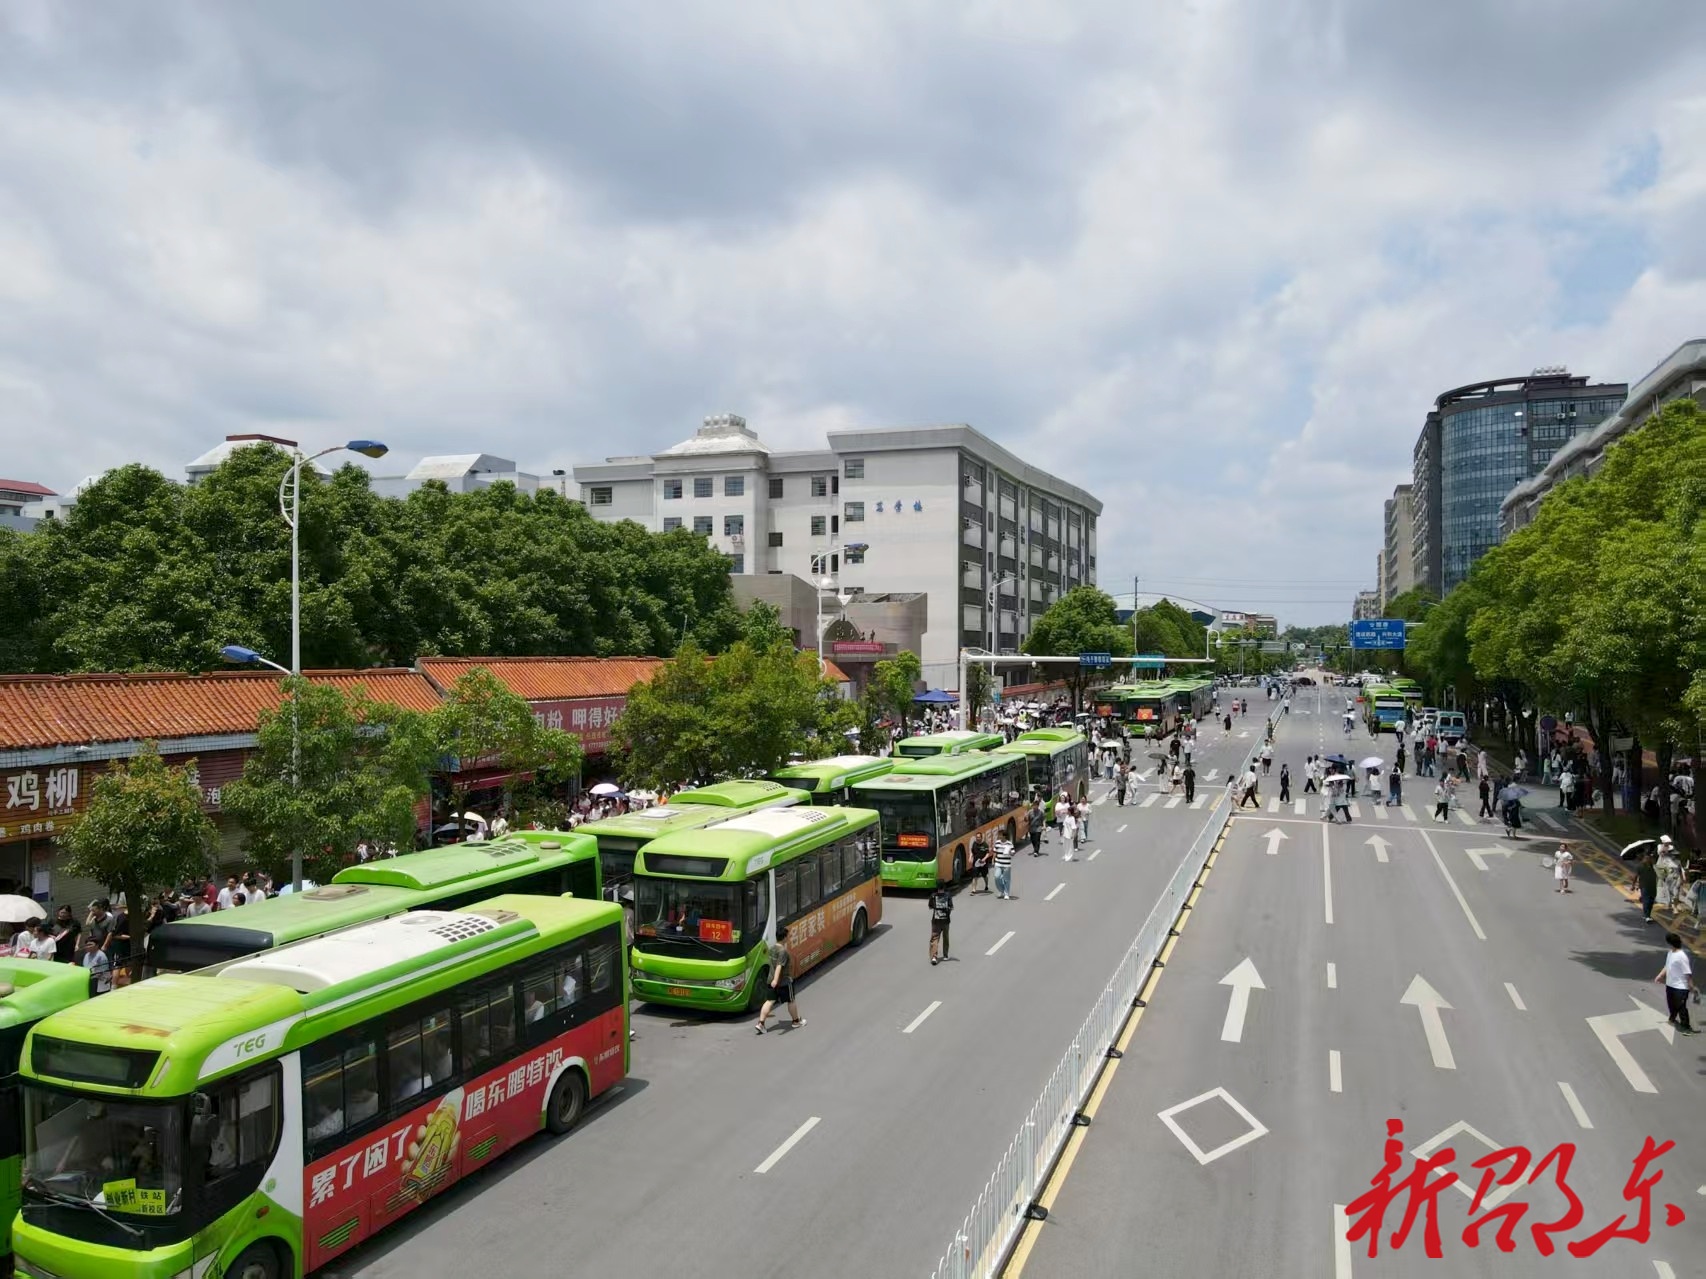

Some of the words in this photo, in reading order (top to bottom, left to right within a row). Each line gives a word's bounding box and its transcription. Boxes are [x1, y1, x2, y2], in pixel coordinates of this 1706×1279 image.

[572, 705, 627, 730] 呷得好
[6, 767, 79, 811] 鸡柳
[711, 931, 721, 940] 12
[233, 1032, 266, 1057] TEG
[465, 1047, 564, 1121] 喝东鹏特饮
[310, 1124, 413, 1208] 累了困了
